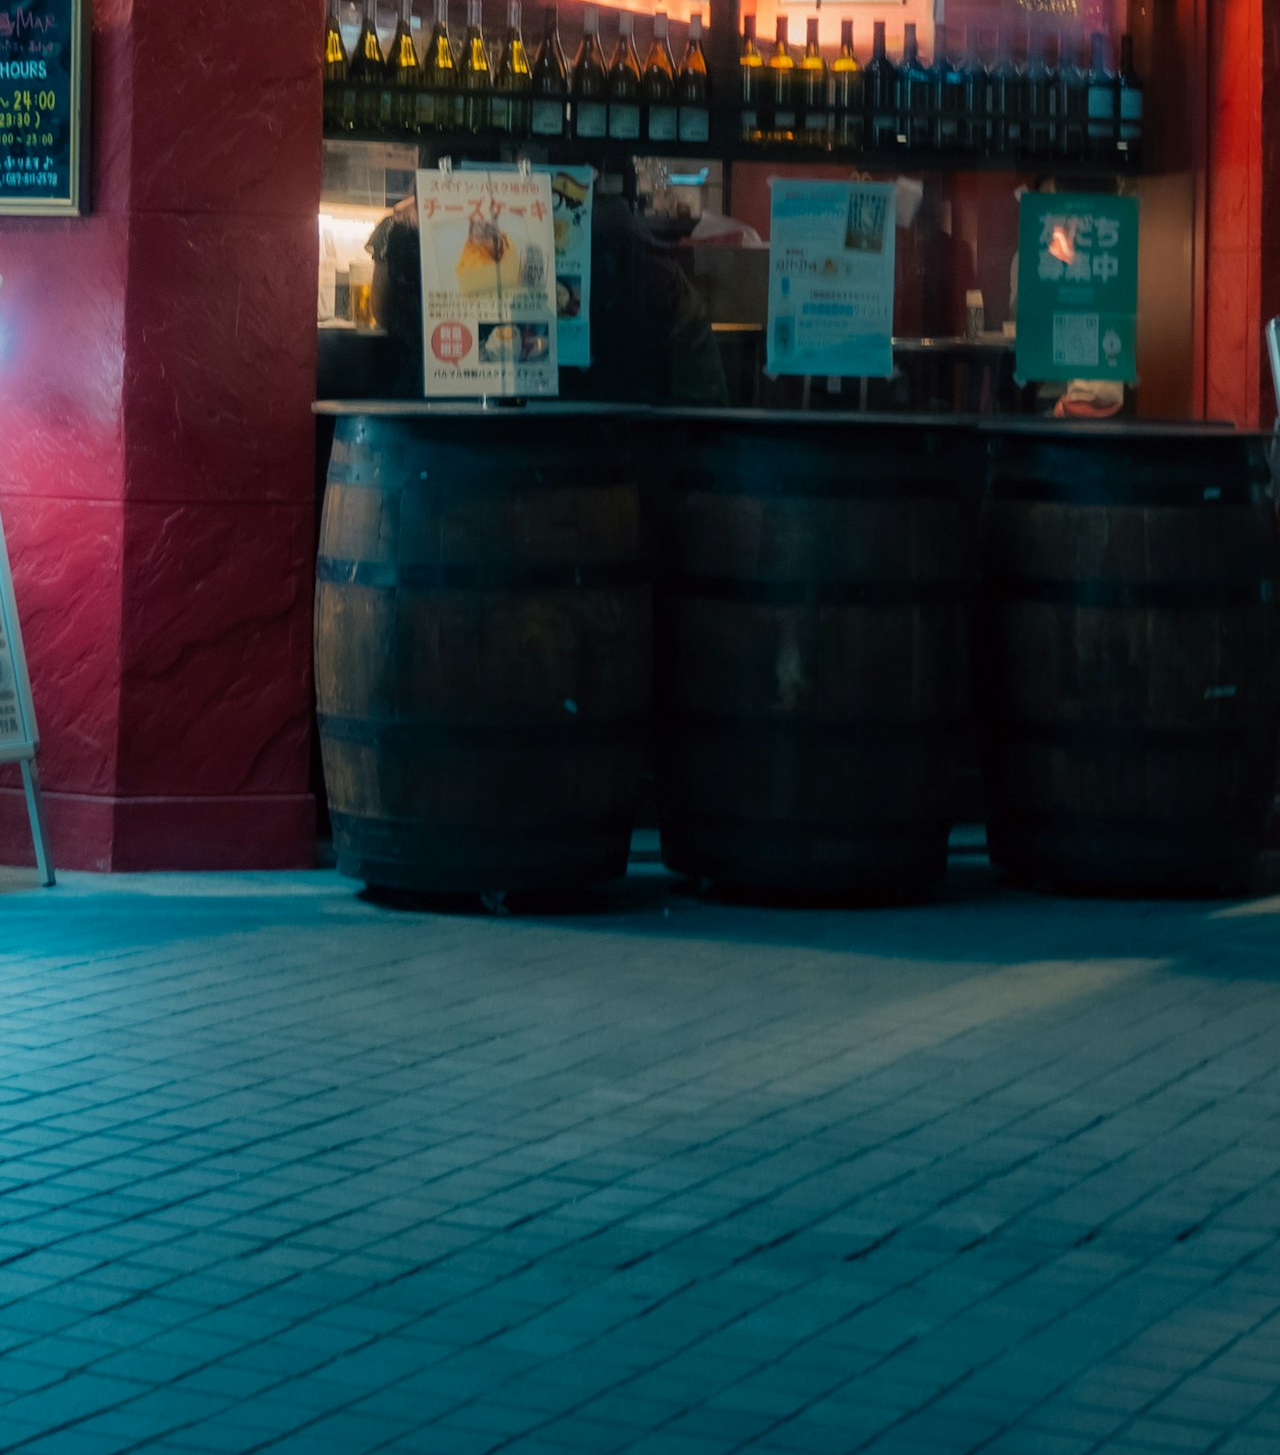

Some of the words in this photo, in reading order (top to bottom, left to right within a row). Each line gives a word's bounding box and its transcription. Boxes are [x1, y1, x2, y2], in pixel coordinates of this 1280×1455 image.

[0, 59, 48, 80] HOURS
[13, 90, 57, 112] 24:00
[423, 197, 549, 222] チーズケーキ
